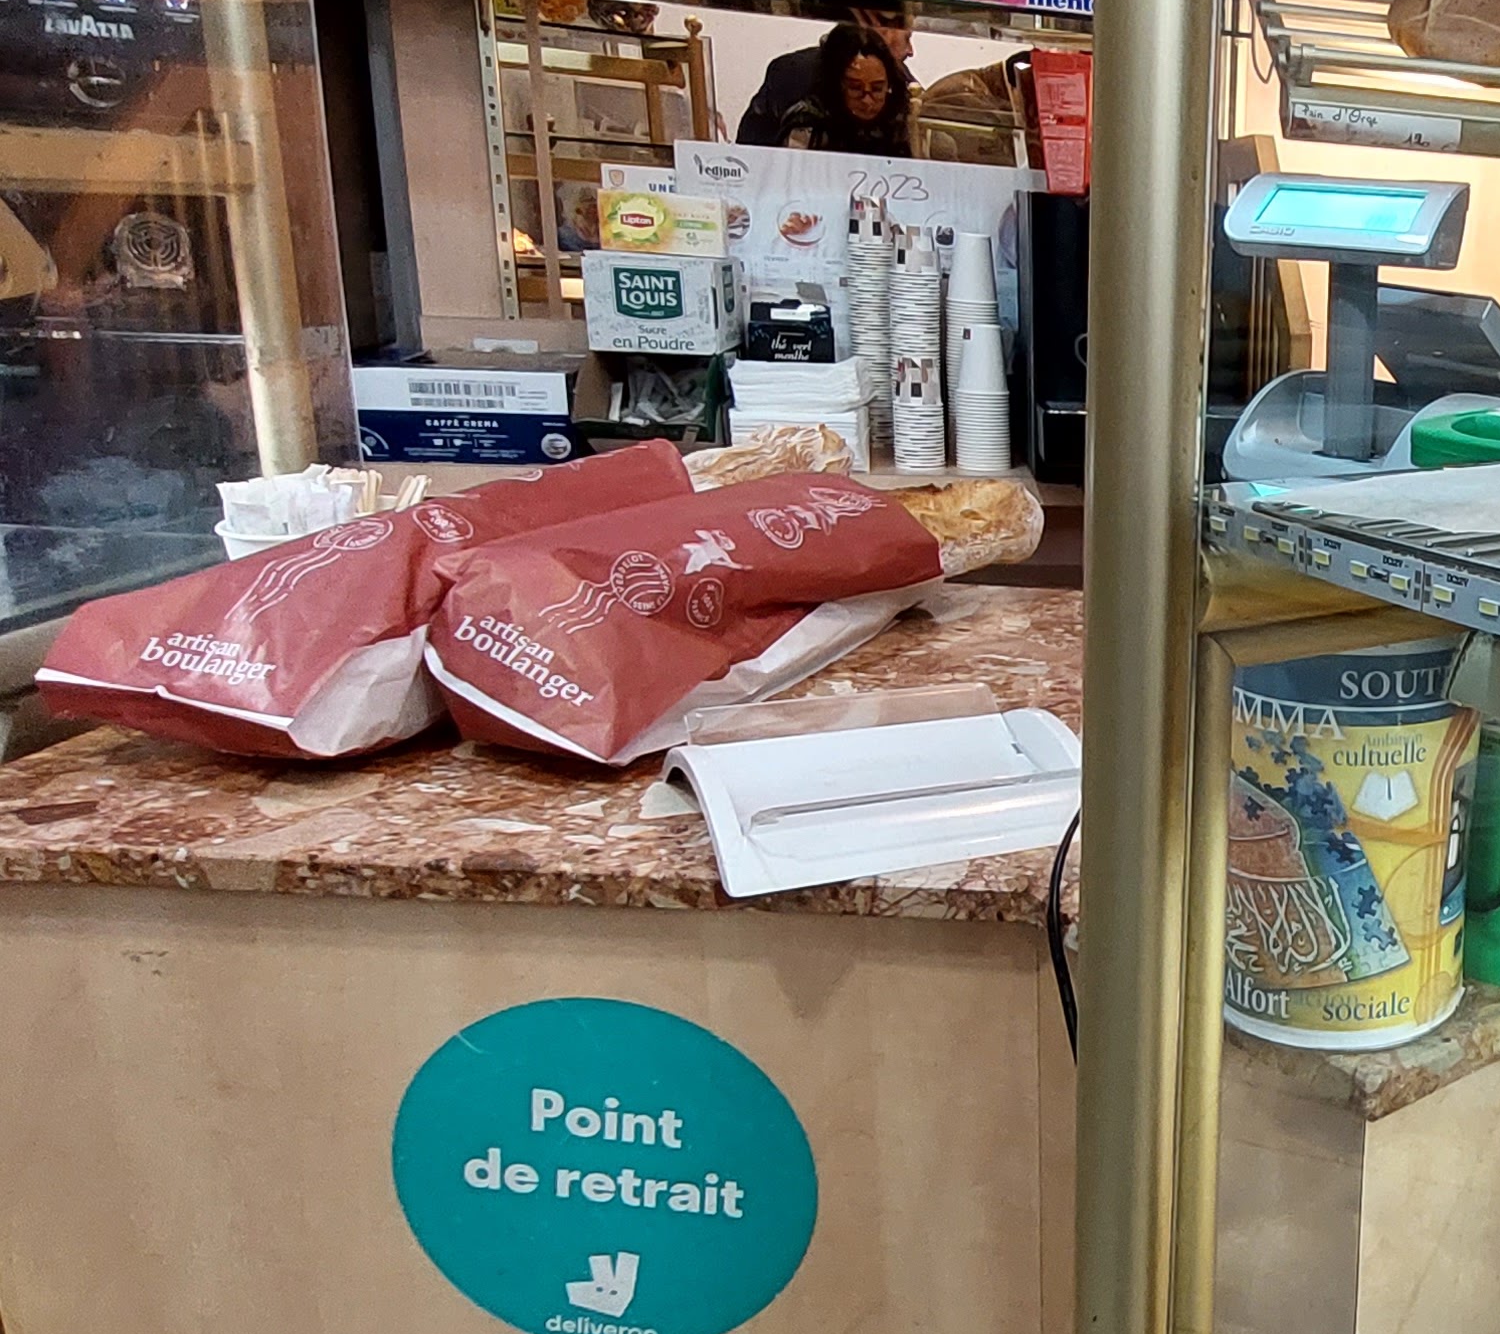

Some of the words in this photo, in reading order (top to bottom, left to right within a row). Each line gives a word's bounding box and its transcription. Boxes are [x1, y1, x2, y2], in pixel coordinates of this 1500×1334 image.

[44, 14, 136, 41] LAVAZZA
[847, 170, 930, 202] 2023
[622, 215, 653, 227] Lipton
[618, 271, 677, 292] SAINT
[620, 289, 679, 309] LOUIS
[612, 338, 634, 349] en
[637, 334, 696, 352] Poudre
[637, 324, 669, 336] Sucre
[425, 418, 461, 428] CAFFÈ
[463, 419, 500, 429] CREMA
[167, 629, 242, 657] artisan
[477, 615, 557, 666] artisan
[139, 636, 277, 686] boulanger
[453, 616, 597, 709] boulanger
[1233, 686, 1346, 741] MMA
[1332, 739, 1428, 767] cultuelle
[1225, 966, 1291, 1019] Alfort
[1321, 990, 1411, 1022] sociale
[530, 1088, 684, 1150] Point
[463, 1147, 540, 1195] de
[556, 1167, 746, 1219] retrait
